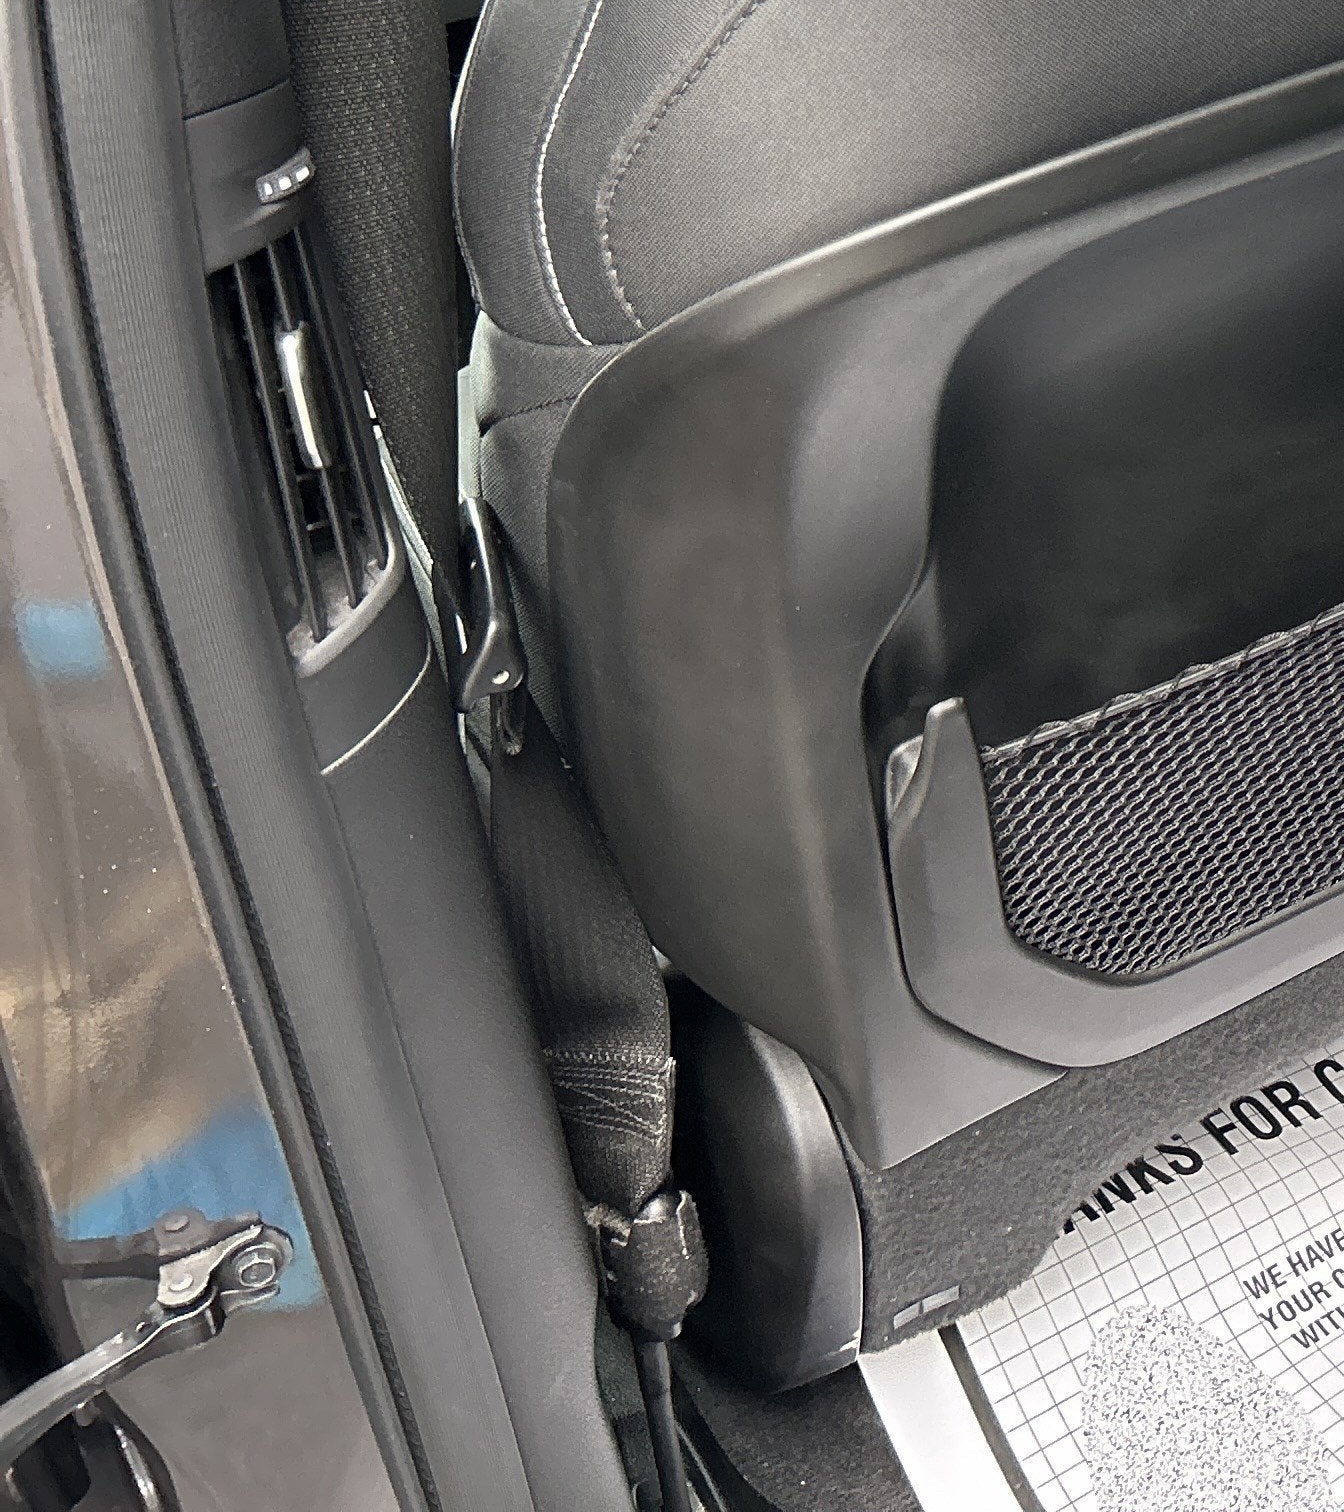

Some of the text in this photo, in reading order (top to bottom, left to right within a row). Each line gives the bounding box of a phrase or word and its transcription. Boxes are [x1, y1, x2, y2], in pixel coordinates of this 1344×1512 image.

[1200, 1079, 1323, 1155] FOR
[1242, 1263, 1287, 1300] WE
[1258, 1280, 1332, 1332] YOUR
